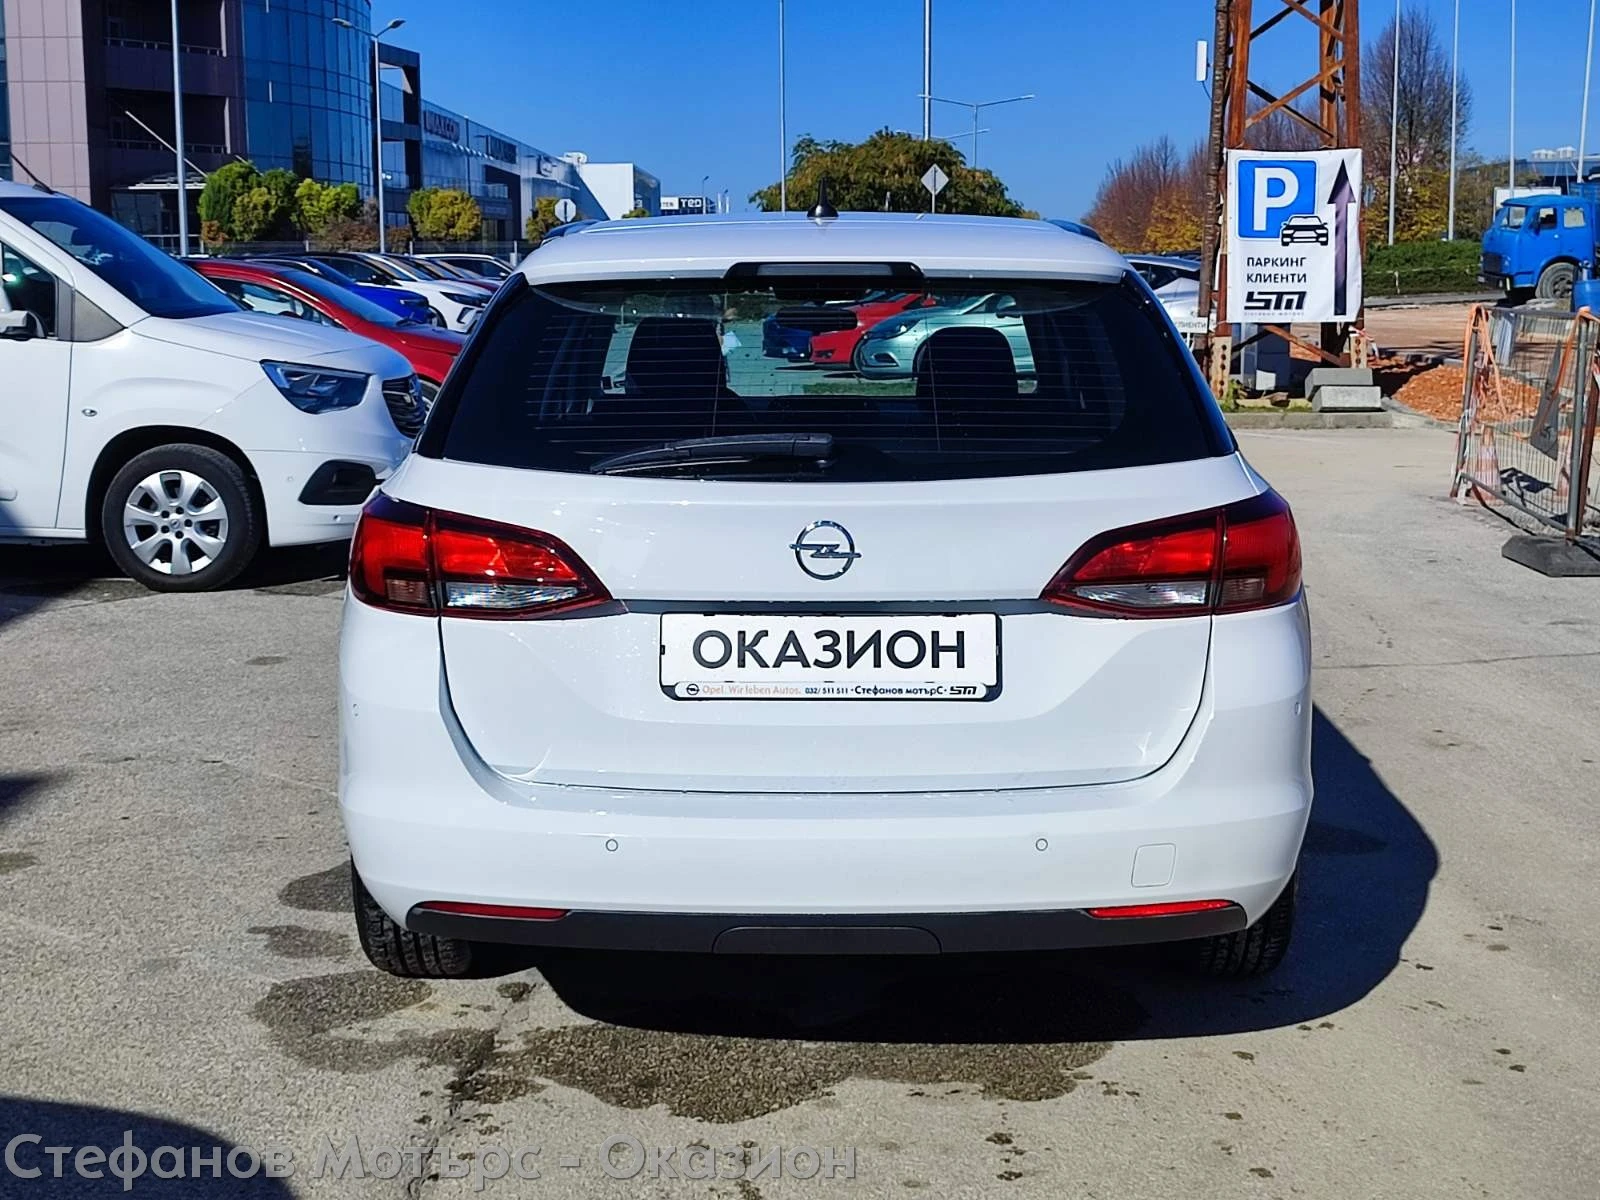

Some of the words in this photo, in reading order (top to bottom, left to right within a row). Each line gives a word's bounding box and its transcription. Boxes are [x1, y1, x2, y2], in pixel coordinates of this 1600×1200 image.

[1253, 167, 1299, 232] P
[1246, 257, 1307, 268] ПАРКИНГ
[1246, 273, 1307, 283] КЛИЕНТИ
[692, 629, 966, 669] ОКАЗИОН
[854, 685, 903, 696] Стефанов
